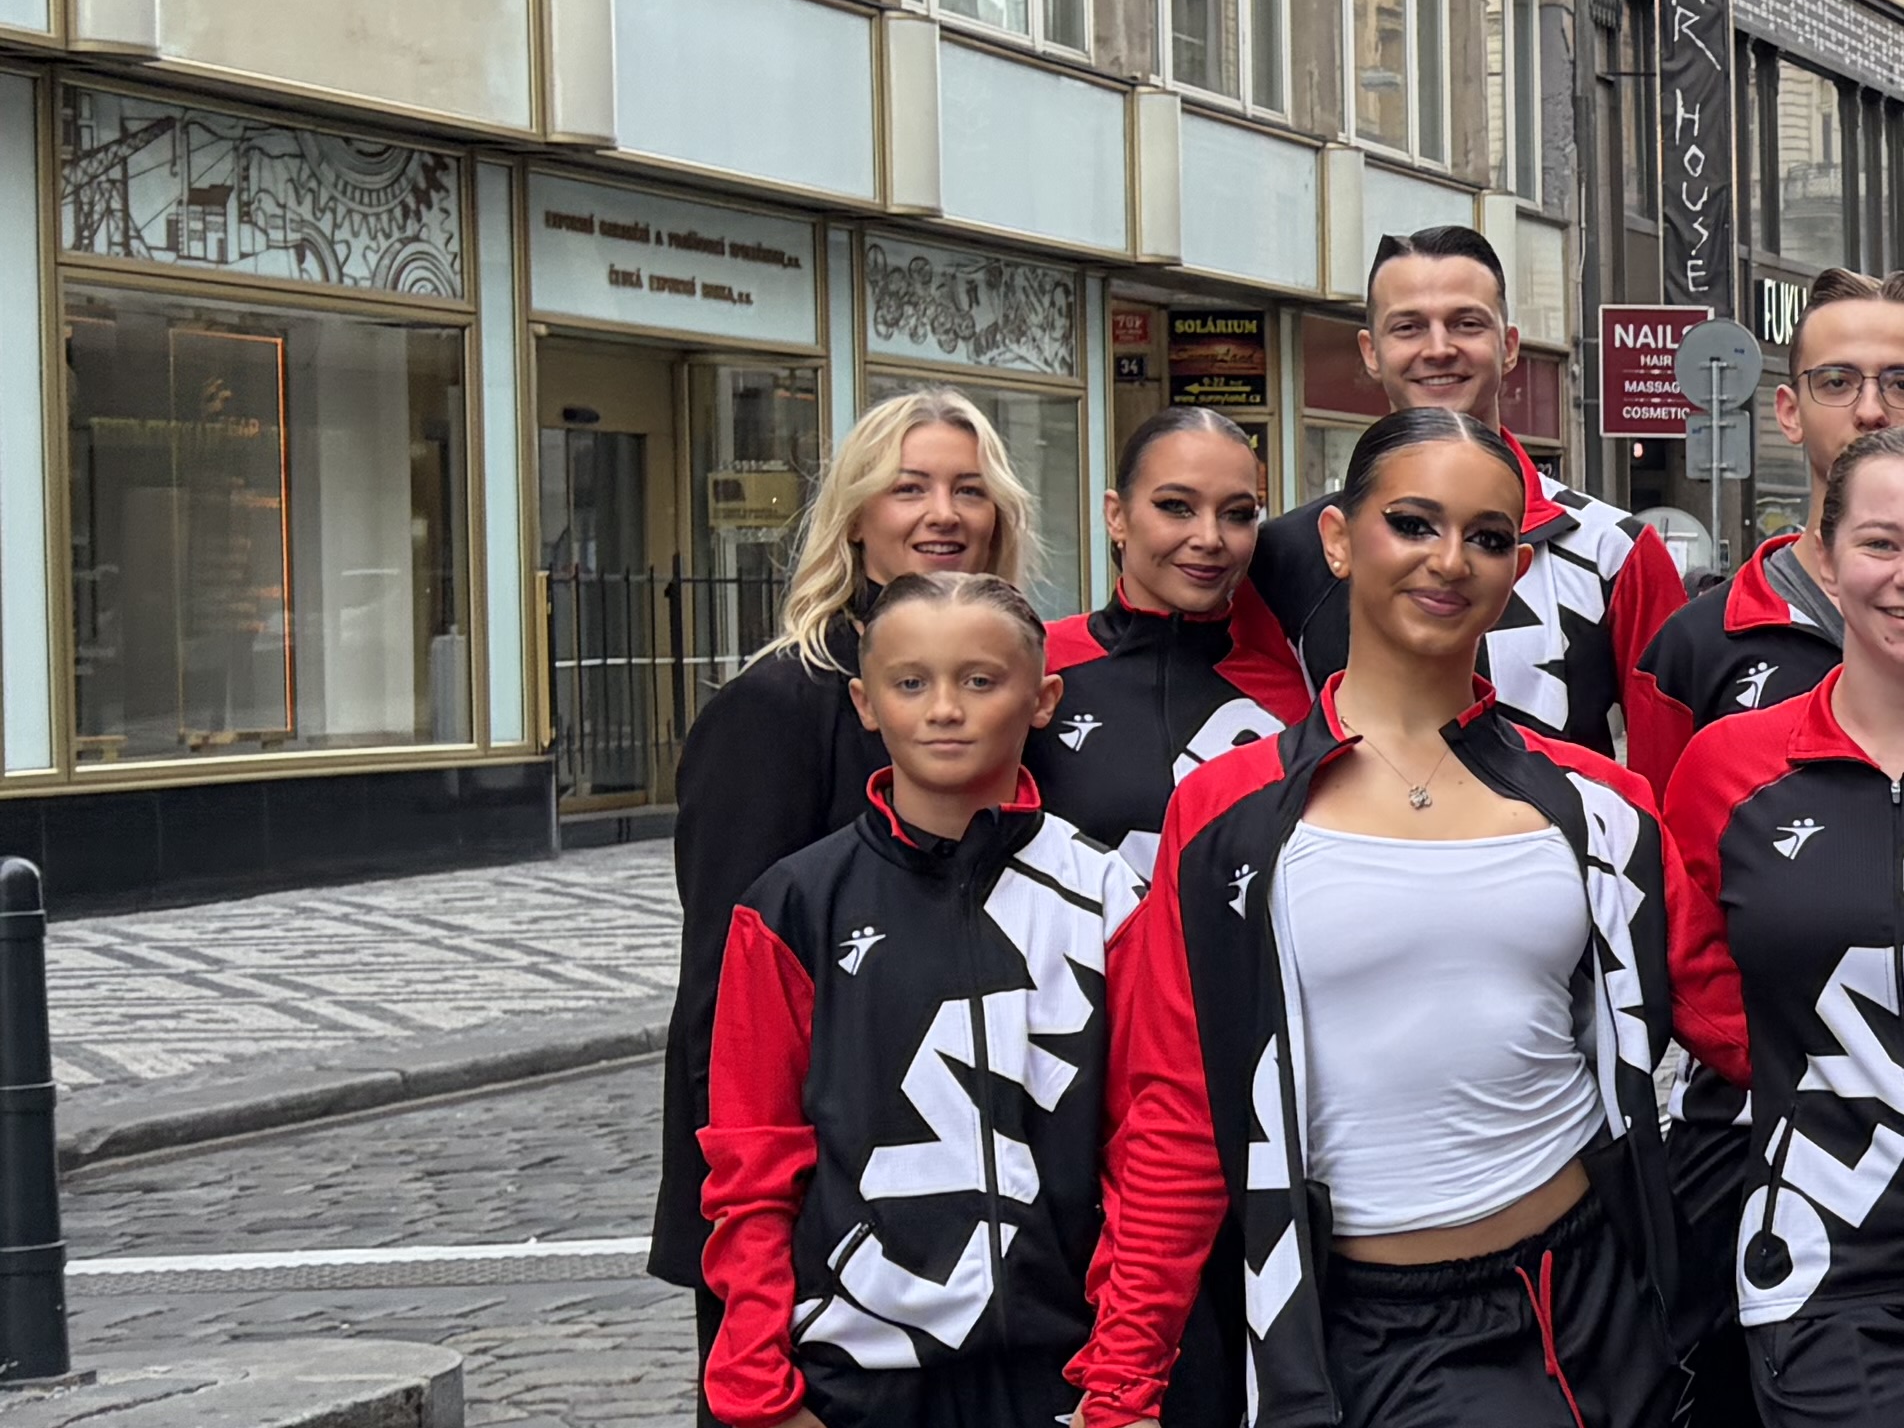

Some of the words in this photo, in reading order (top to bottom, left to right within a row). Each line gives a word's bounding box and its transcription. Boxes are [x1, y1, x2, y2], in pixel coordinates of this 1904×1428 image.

[1675, 88, 1709, 293] HOUSE
[1764, 278, 1808, 345] FUK
[1174, 316, 1258, 334] SOLÁRIUM
[1120, 359, 1139, 375] 34
[1640, 354, 1673, 367] HAIR
[1624, 380, 1682, 394] MASSAG
